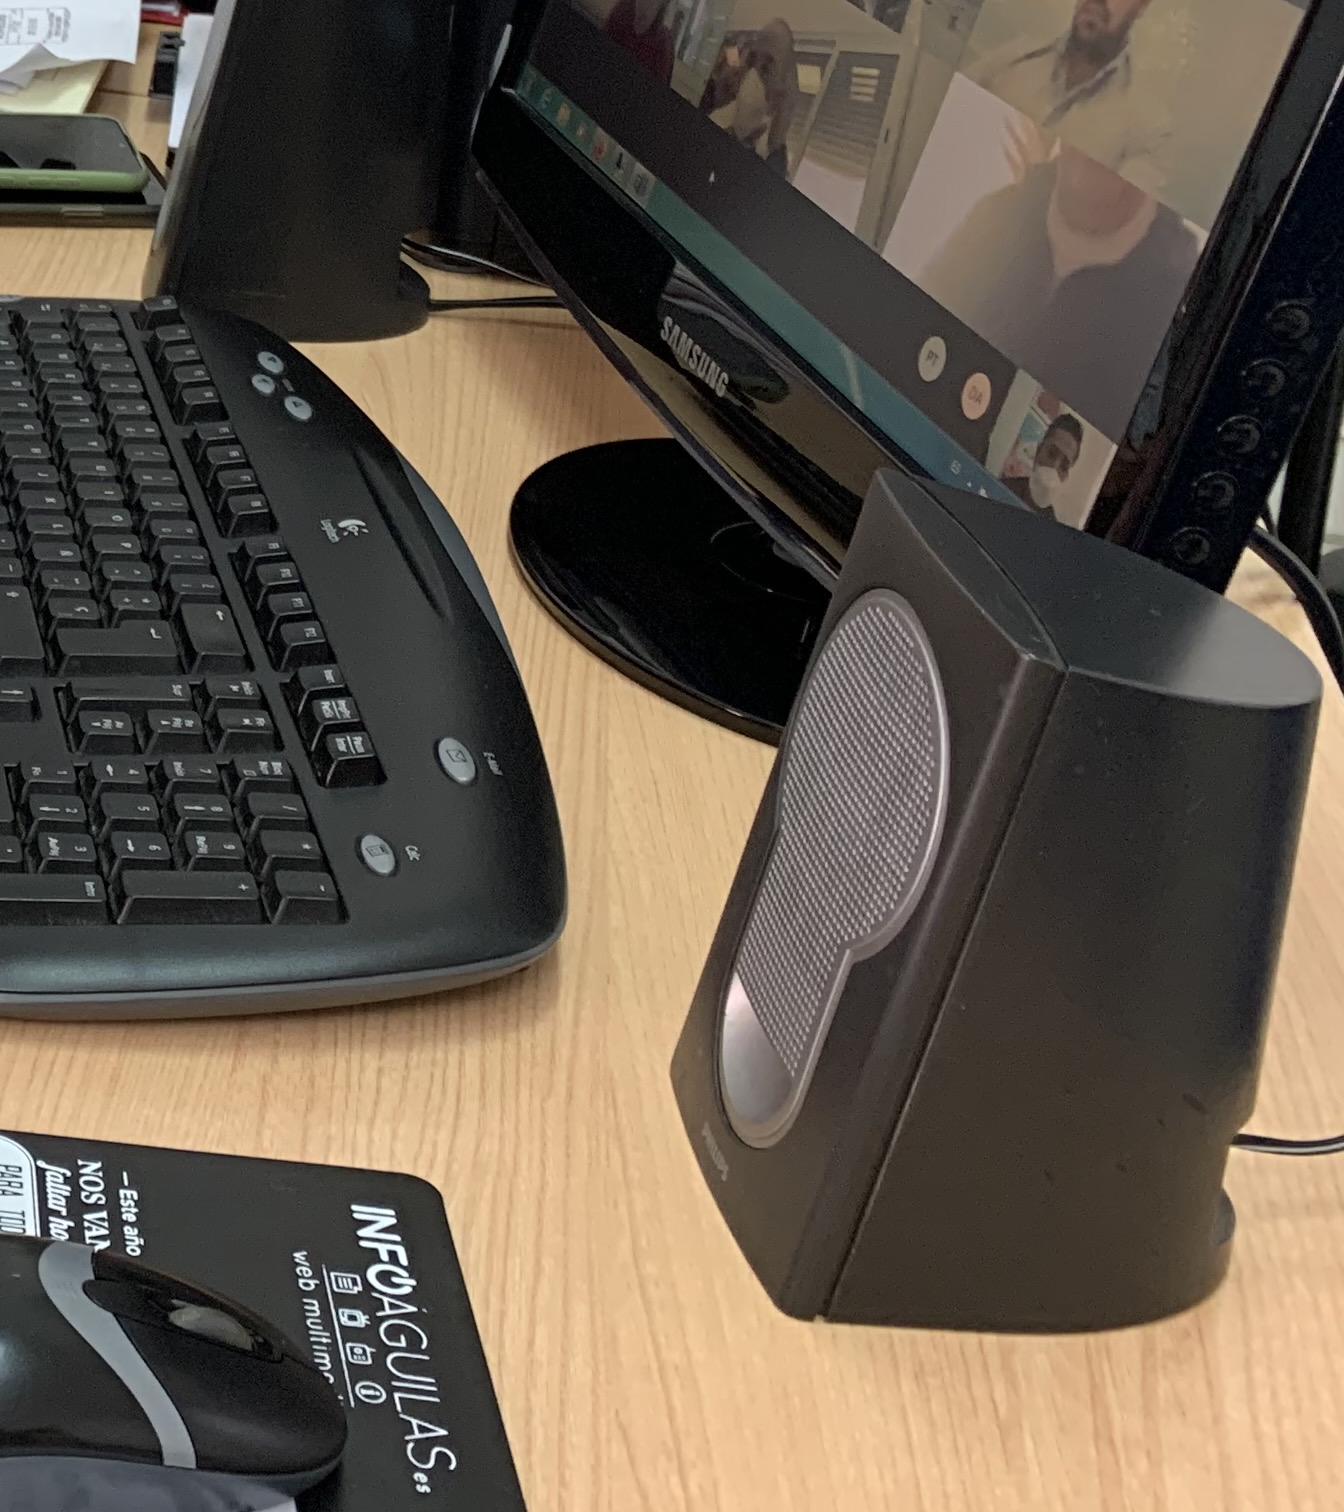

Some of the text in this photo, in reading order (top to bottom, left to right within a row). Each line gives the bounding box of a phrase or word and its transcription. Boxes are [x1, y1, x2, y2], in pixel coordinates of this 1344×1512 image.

[659, 316, 729, 397] SAMSUNG
[36, 1160, 75, 1241] faltar ho
[77, 1159, 106, 1205] NOS
[119, 1189, 145, 1257] Este año
[292, 1250, 338, 1393] web multim
